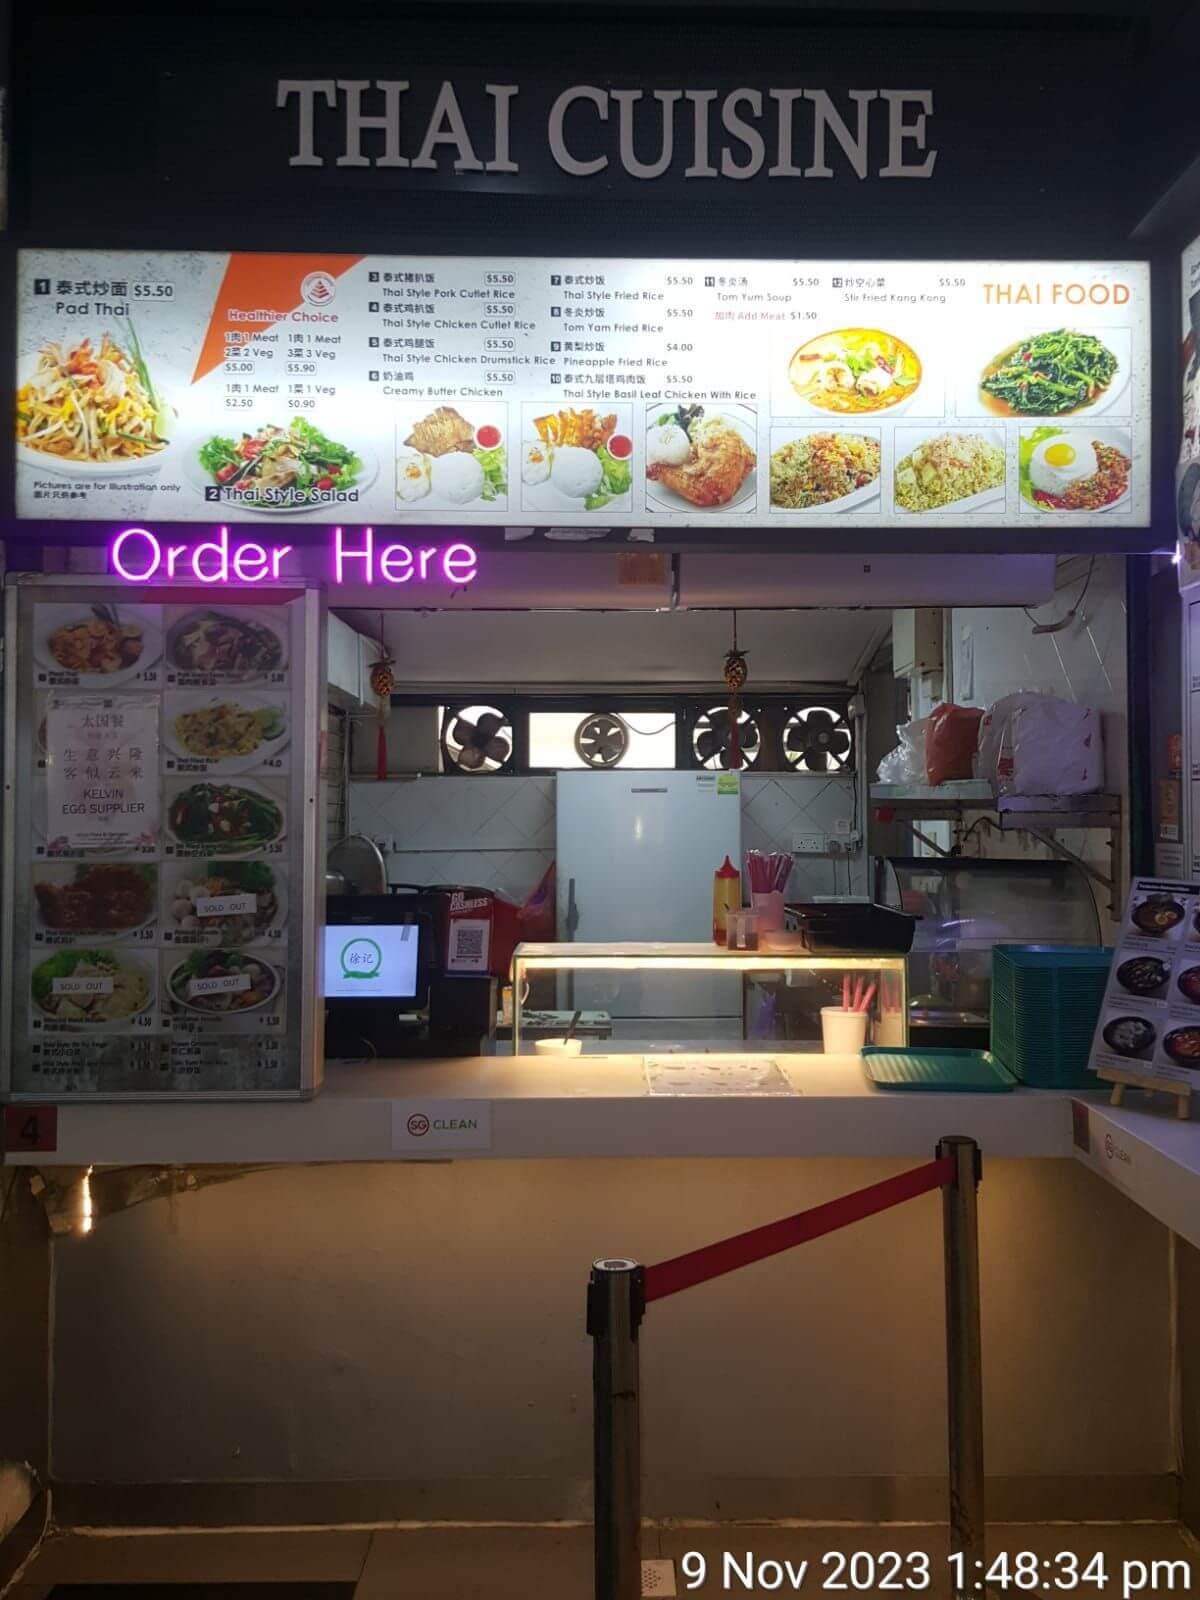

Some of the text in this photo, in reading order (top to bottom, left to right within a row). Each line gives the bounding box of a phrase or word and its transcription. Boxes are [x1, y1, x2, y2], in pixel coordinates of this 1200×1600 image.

[276, 79, 938, 181] THAI CUISINE
[486, 275, 514, 284] $5.50
[564, 275, 605, 286] 泰式炒饭
[666, 277, 693, 286] $5.50
[792, 277, 820, 287] $5.50
[939, 278, 966, 287] $5.50
[56, 280, 128, 296] 泰式炒面
[134, 285, 173, 297] $5.50
[383, 288, 515, 299] Thai Style Pork Cutlet Rice
[982, 283, 1130, 305] THAI FOOD
[563, 290, 665, 301] Thai Style Fried Rice
[717, 292, 792, 303] Tom Yum Soup
[844, 293, 859, 302] Stir
[862, 293, 887, 302] Fried
[890, 294, 916, 304] Kang
[56, 302, 129, 316] Pad Thai
[486, 305, 514, 314] $5.50
[666, 309, 693, 318] $5.50
[229, 310, 339, 323] Healthier Choice
[737, 311, 758, 320] Add
[760, 311, 786, 320] Meat
[790, 311, 817, 320] $1.50
[383, 319, 536, 330] Thai Style Chicken Cutlet Rice
[563, 323, 664, 333] Tom Yam Fried Rice
[253, 333, 280, 343] Meat
[315, 334, 342, 344] Meat
[486, 340, 514, 349] $5.50
[666, 343, 693, 352] $4.00
[253, 348, 274, 359] Veg
[315, 349, 336, 360] Veg
[383, 354, 556, 365] Thai Style Chicken Drumstick Rice
[563, 357, 668, 368] Pineapple Fried Rice
[225, 363, 253, 372] $5.00
[287, 363, 316, 373] $5.90
[486, 374, 514, 382] $5.50
[666, 375, 693, 384] $5.50
[253, 384, 280, 393] Meat
[315, 385, 336, 396] Veg
[383, 386, 503, 397] Creamy Butter Chicken
[563, 389, 757, 400] Thai Style Basil Leaf Chicken With Rice
[225, 398, 253, 408] $2.50
[288, 399, 316, 408] $0.90
[33, 480, 72, 490] Pictures
[94, 482, 106, 491] for
[160, 483, 181, 493] only
[225, 487, 259, 501] Thai
[264, 487, 305, 503] Style
[311, 488, 360, 502] Salad
[112, 526, 478, 585] Order Here
[83, 788, 124, 800] KELVIN
[62, 802, 145, 815] EGG SUPPLIER
[204, 902, 248, 913] SOLD OUT
[60, 982, 80, 991] SOLD
[20, 1115, 40, 1145] 4
[432, 1119, 478, 1130] CLEAN
